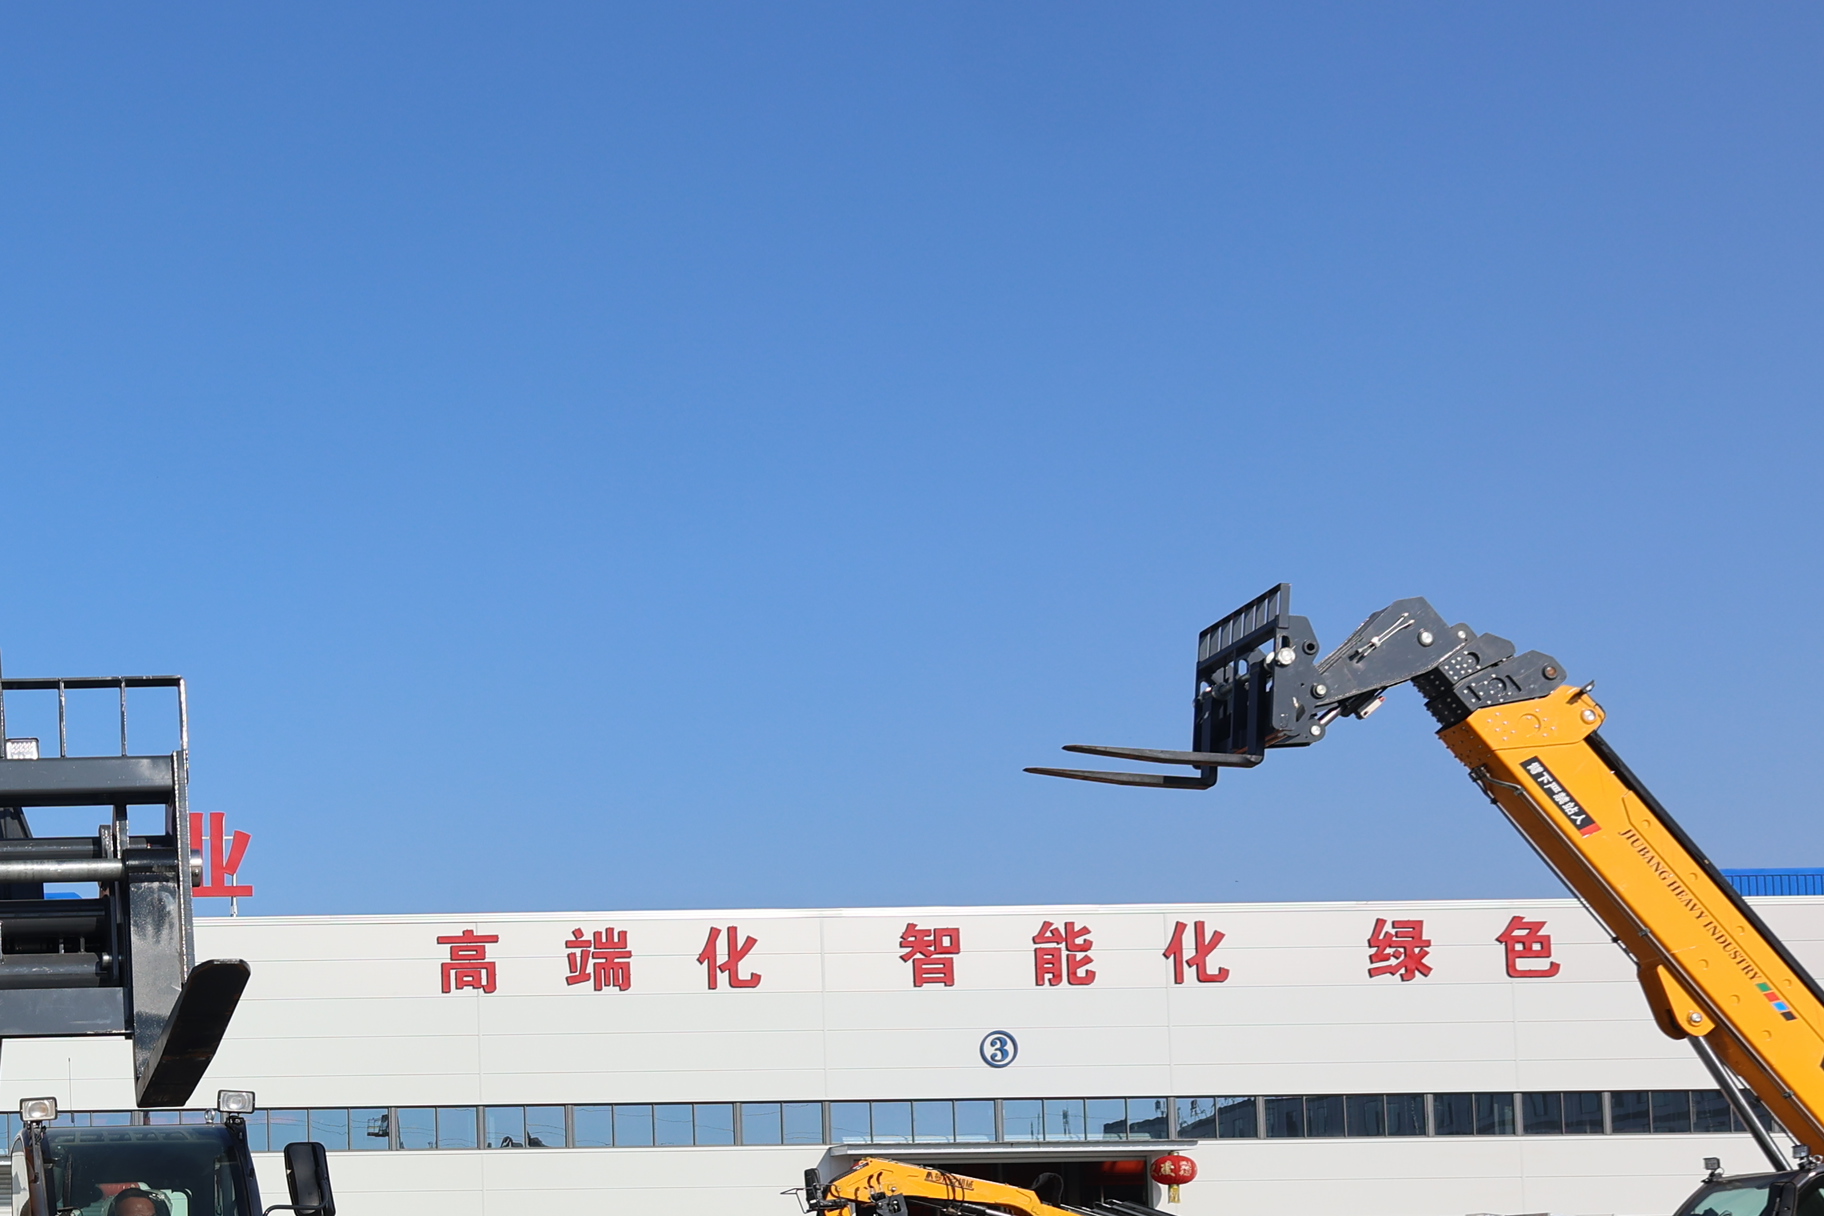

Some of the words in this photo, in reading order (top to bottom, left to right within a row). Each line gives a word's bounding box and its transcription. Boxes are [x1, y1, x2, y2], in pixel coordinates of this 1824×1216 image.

[437, 926, 762, 993] 高端化
[899, 921, 1230, 987] 智能化
[1368, 916, 1561, 981] 绿色
[1618, 828, 1675, 883] JIUBANG
[1667, 877, 1708, 921] HEAVY
[1703, 919, 1762, 981] INDUSTRY
